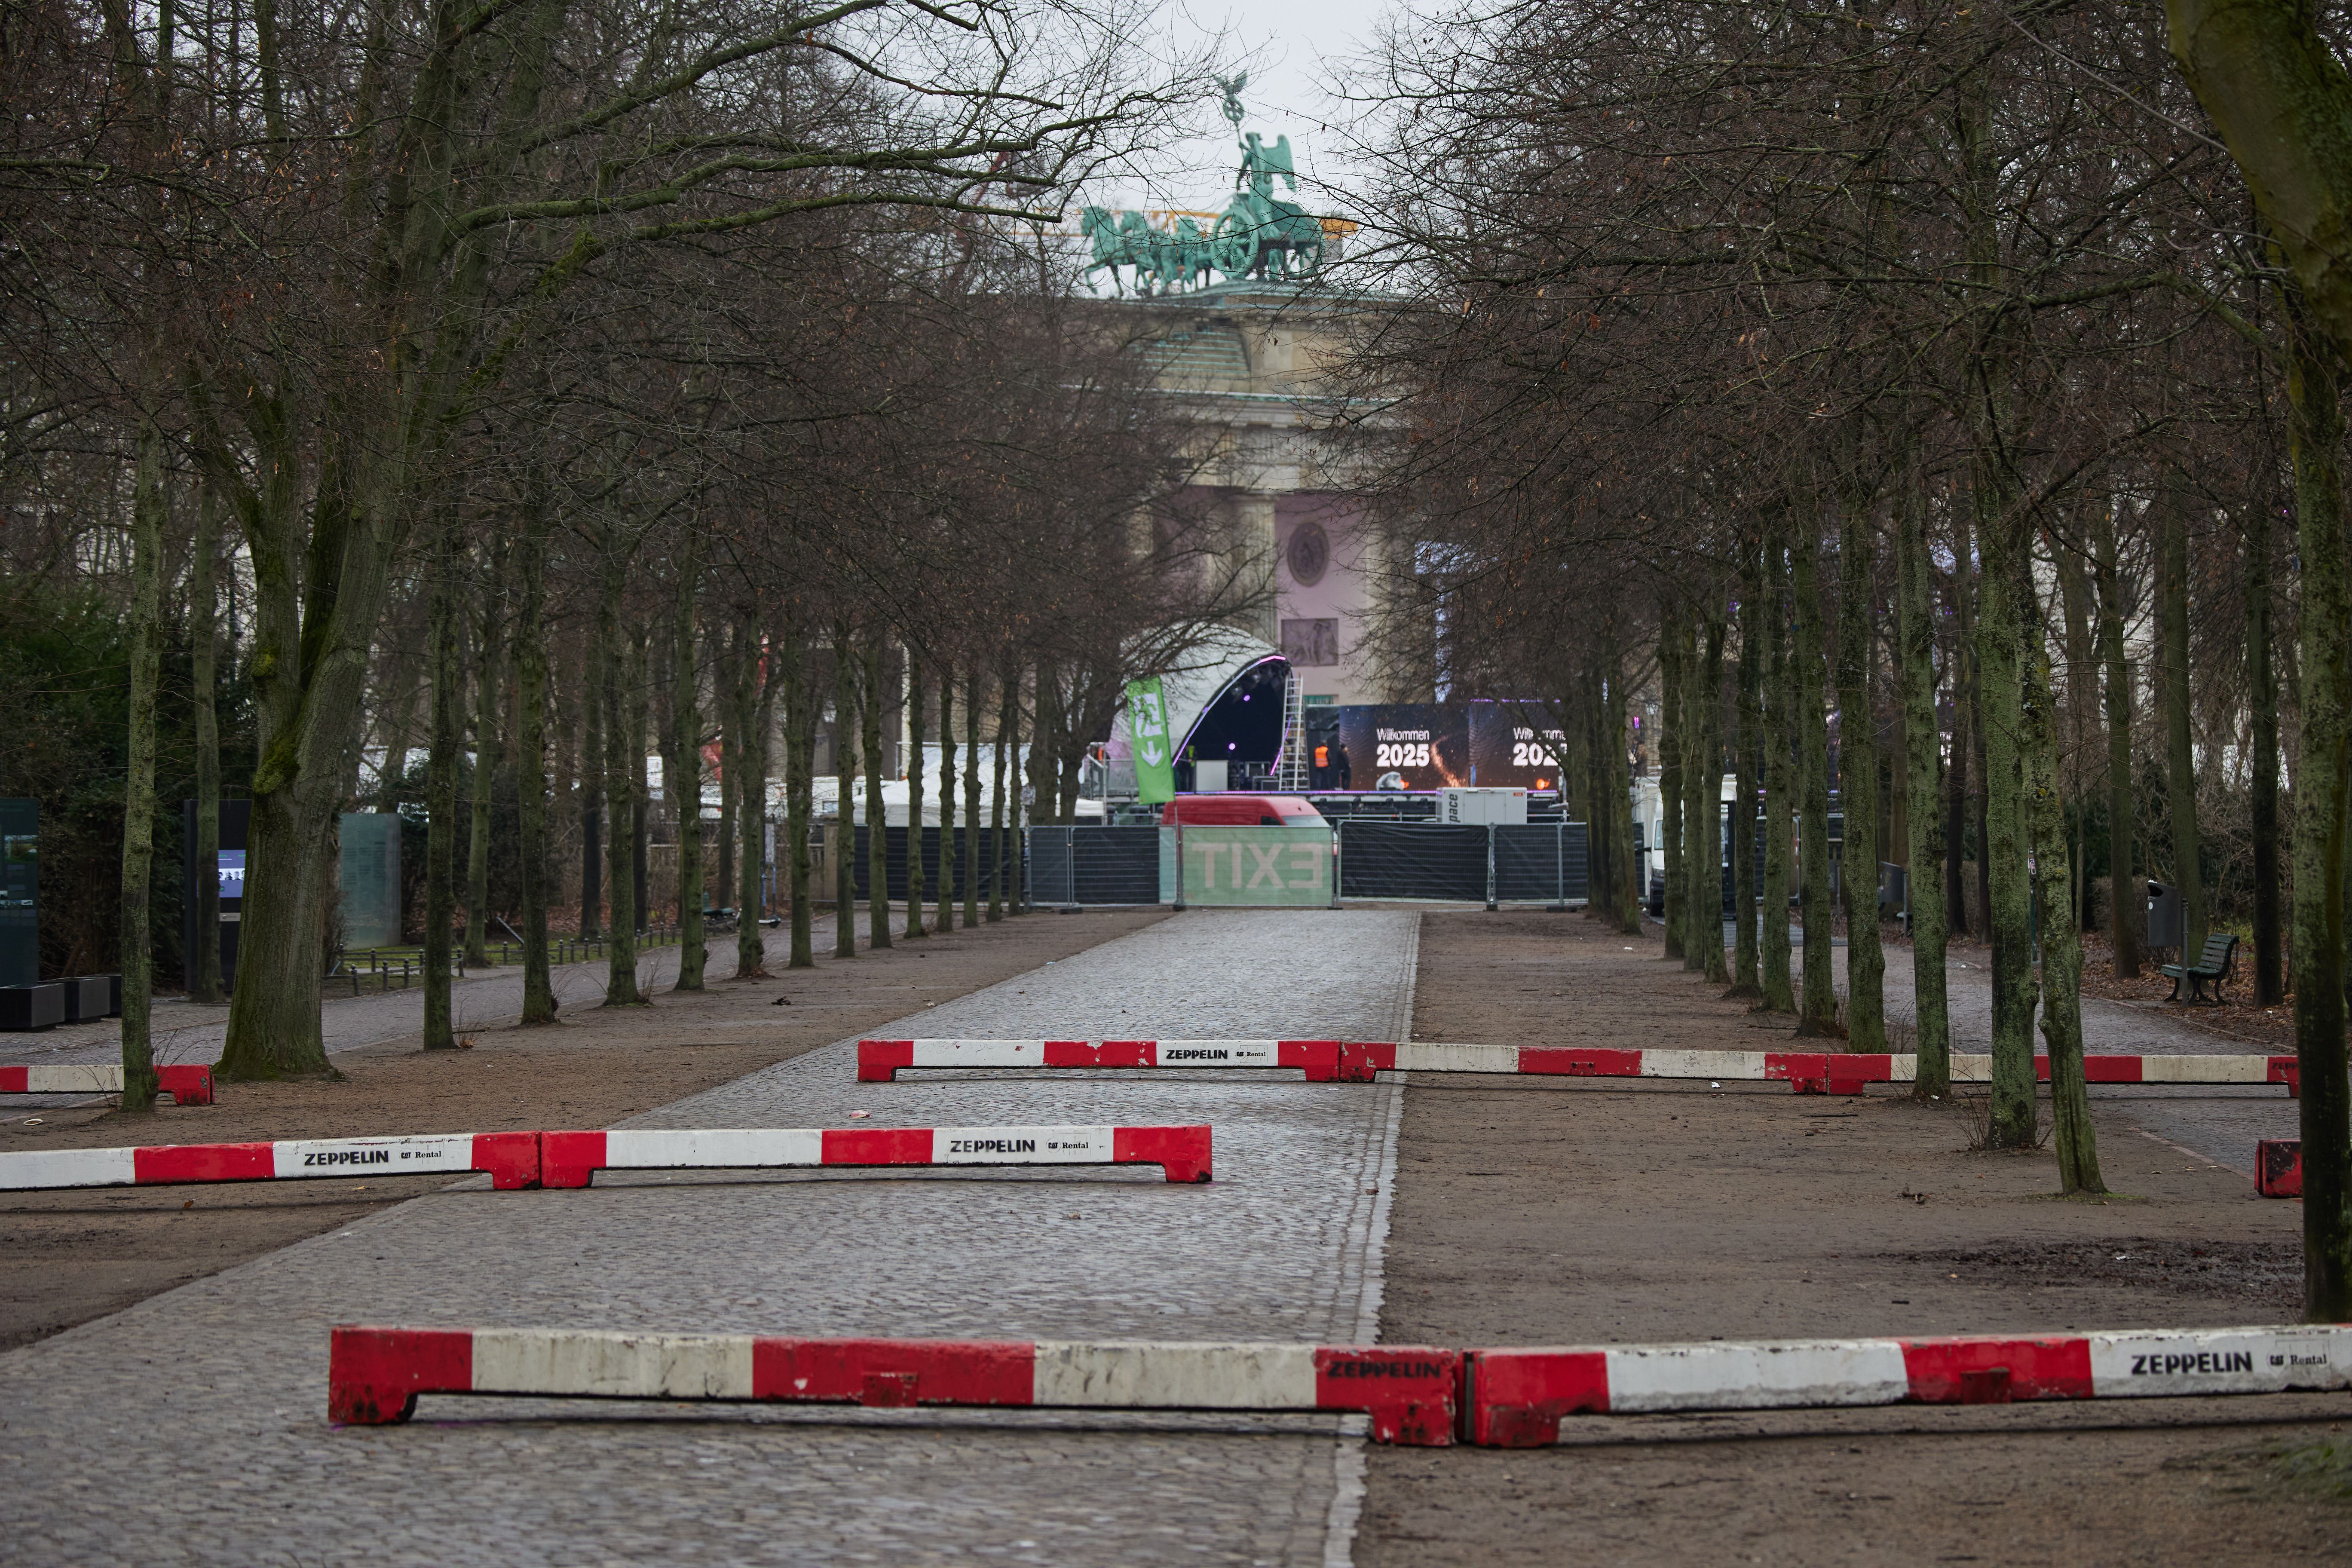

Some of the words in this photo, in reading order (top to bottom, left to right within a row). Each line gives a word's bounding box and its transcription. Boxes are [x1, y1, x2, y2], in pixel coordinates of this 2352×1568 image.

[1376, 728, 1430, 741] Willkommen
[1376, 743, 1430, 767] 2025
[1513, 742, 1567, 766] 202
[1166, 1050, 1228, 1059] ZEPPELIN
[950, 1139, 1035, 1153] ZEPPELIN
[304, 1150, 389, 1166] ZEPPELIN
[1327, 1362, 1441, 1378] ZEPPELIN
[2131, 1351, 2254, 1375] ZEPPELIN
[2290, 1354, 2327, 1365] Rental
